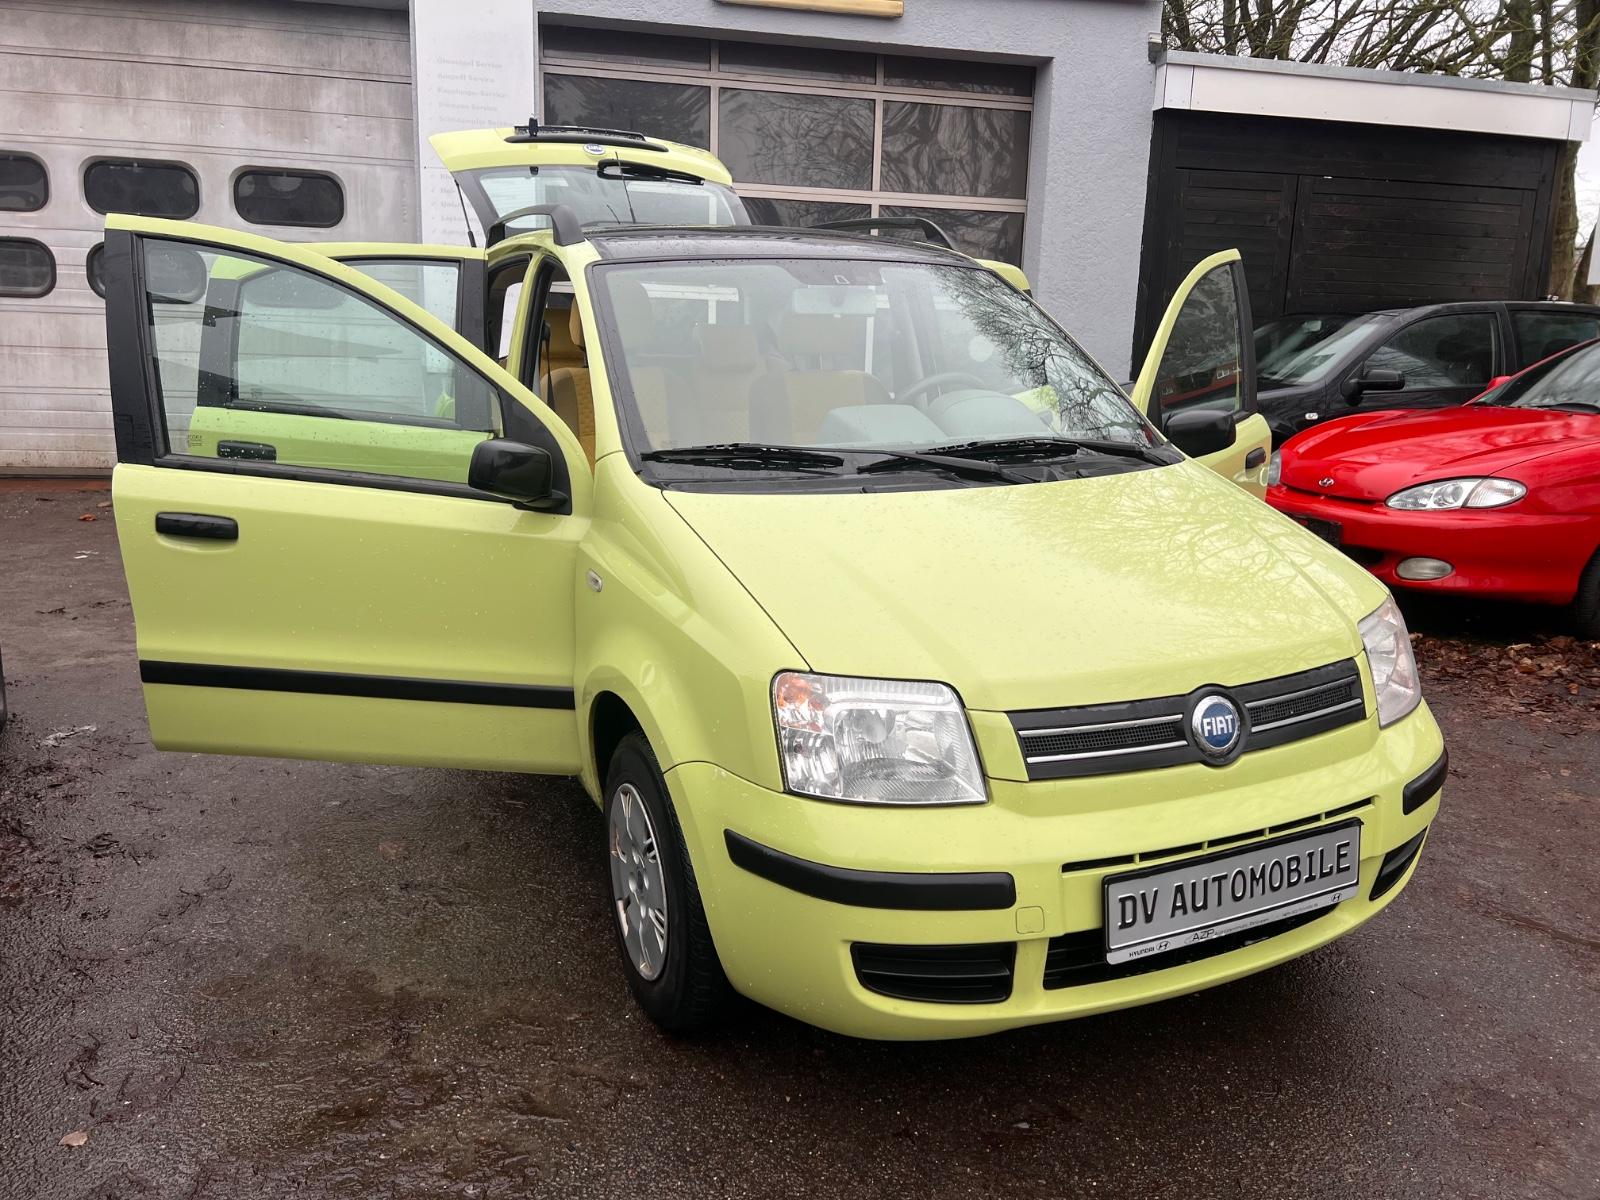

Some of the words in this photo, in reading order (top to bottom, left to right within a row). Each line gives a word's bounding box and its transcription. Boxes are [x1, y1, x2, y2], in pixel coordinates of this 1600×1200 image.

[1202, 714, 1233, 737] FIAT
[1118, 887, 1159, 930] DV
[1170, 840, 1351, 918] AUTOMOBILE
[1192, 928, 1215, 942] AZP
